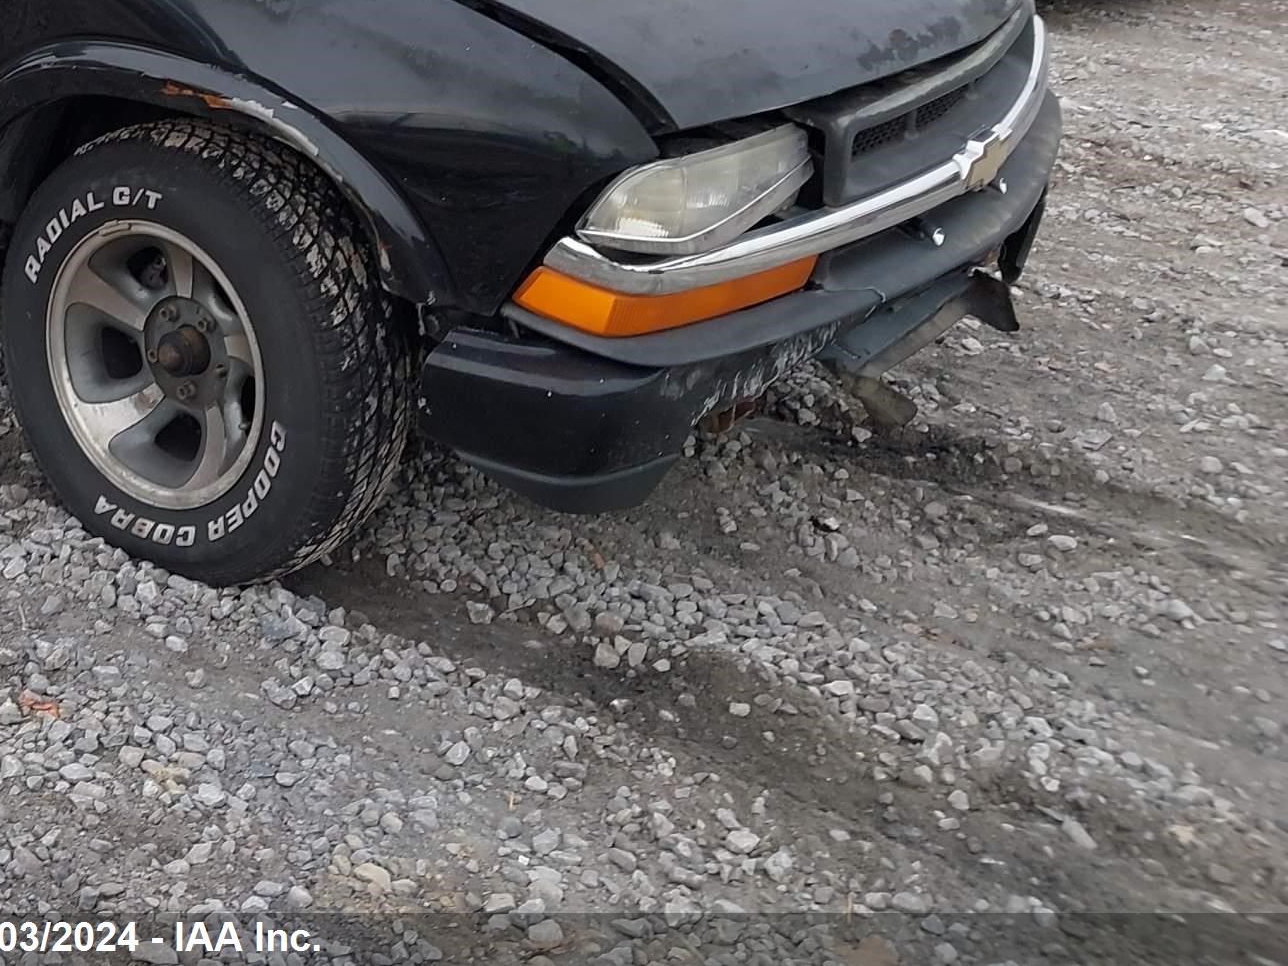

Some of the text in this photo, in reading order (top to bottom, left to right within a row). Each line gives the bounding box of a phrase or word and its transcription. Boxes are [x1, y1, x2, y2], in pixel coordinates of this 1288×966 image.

[23, 186, 164, 284] RADIAL G/T
[94, 420, 287, 547] COOPER COBRA
